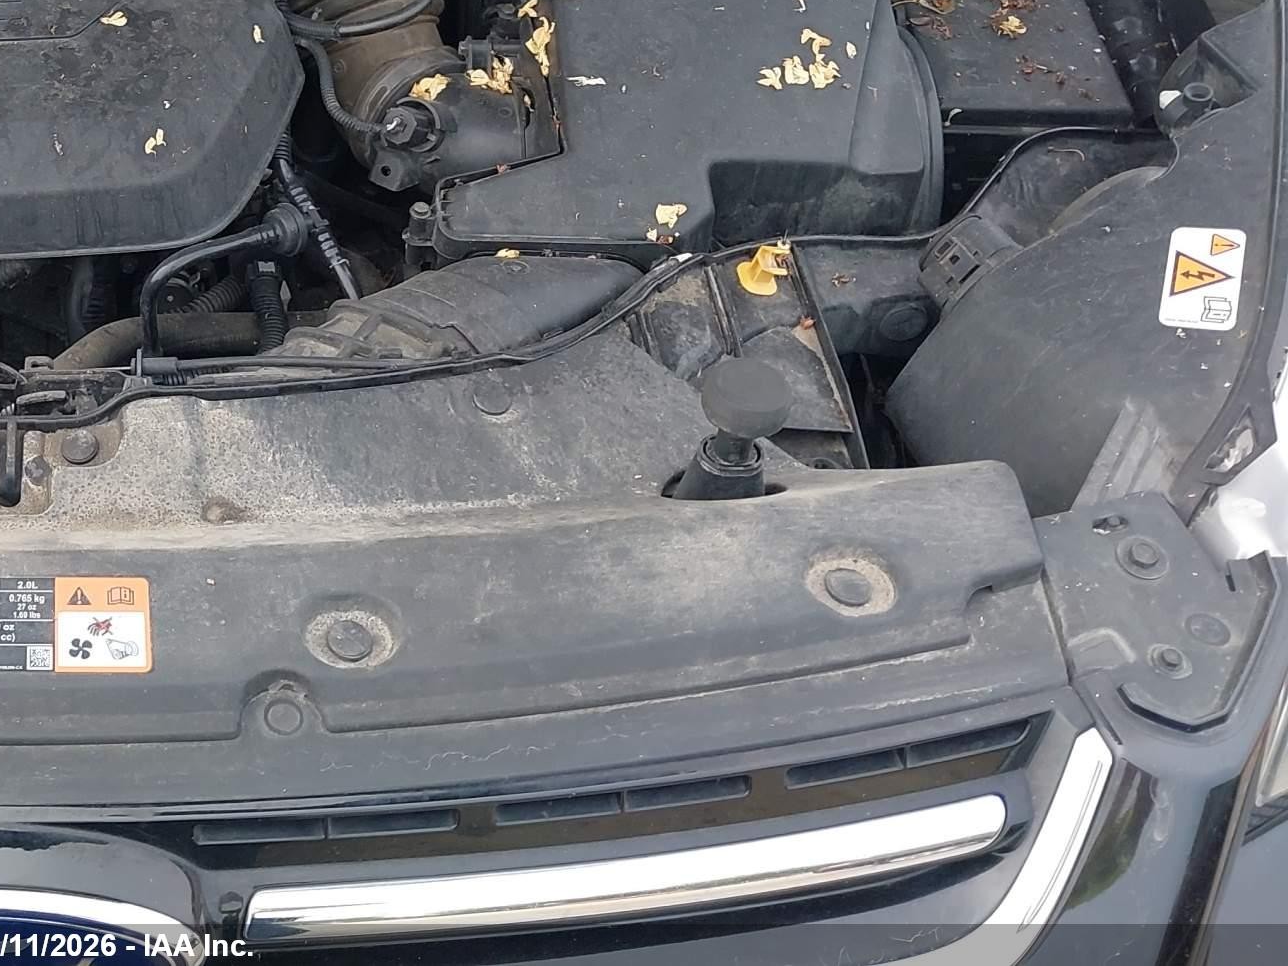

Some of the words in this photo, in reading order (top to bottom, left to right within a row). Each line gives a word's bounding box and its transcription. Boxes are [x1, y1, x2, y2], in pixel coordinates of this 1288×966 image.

[17, 581, 38, 589] 2.0L
[9, 594, 32, 602] 0.765
[34, 594, 45, 604] kg
[0, 633, 16, 642] cc)
